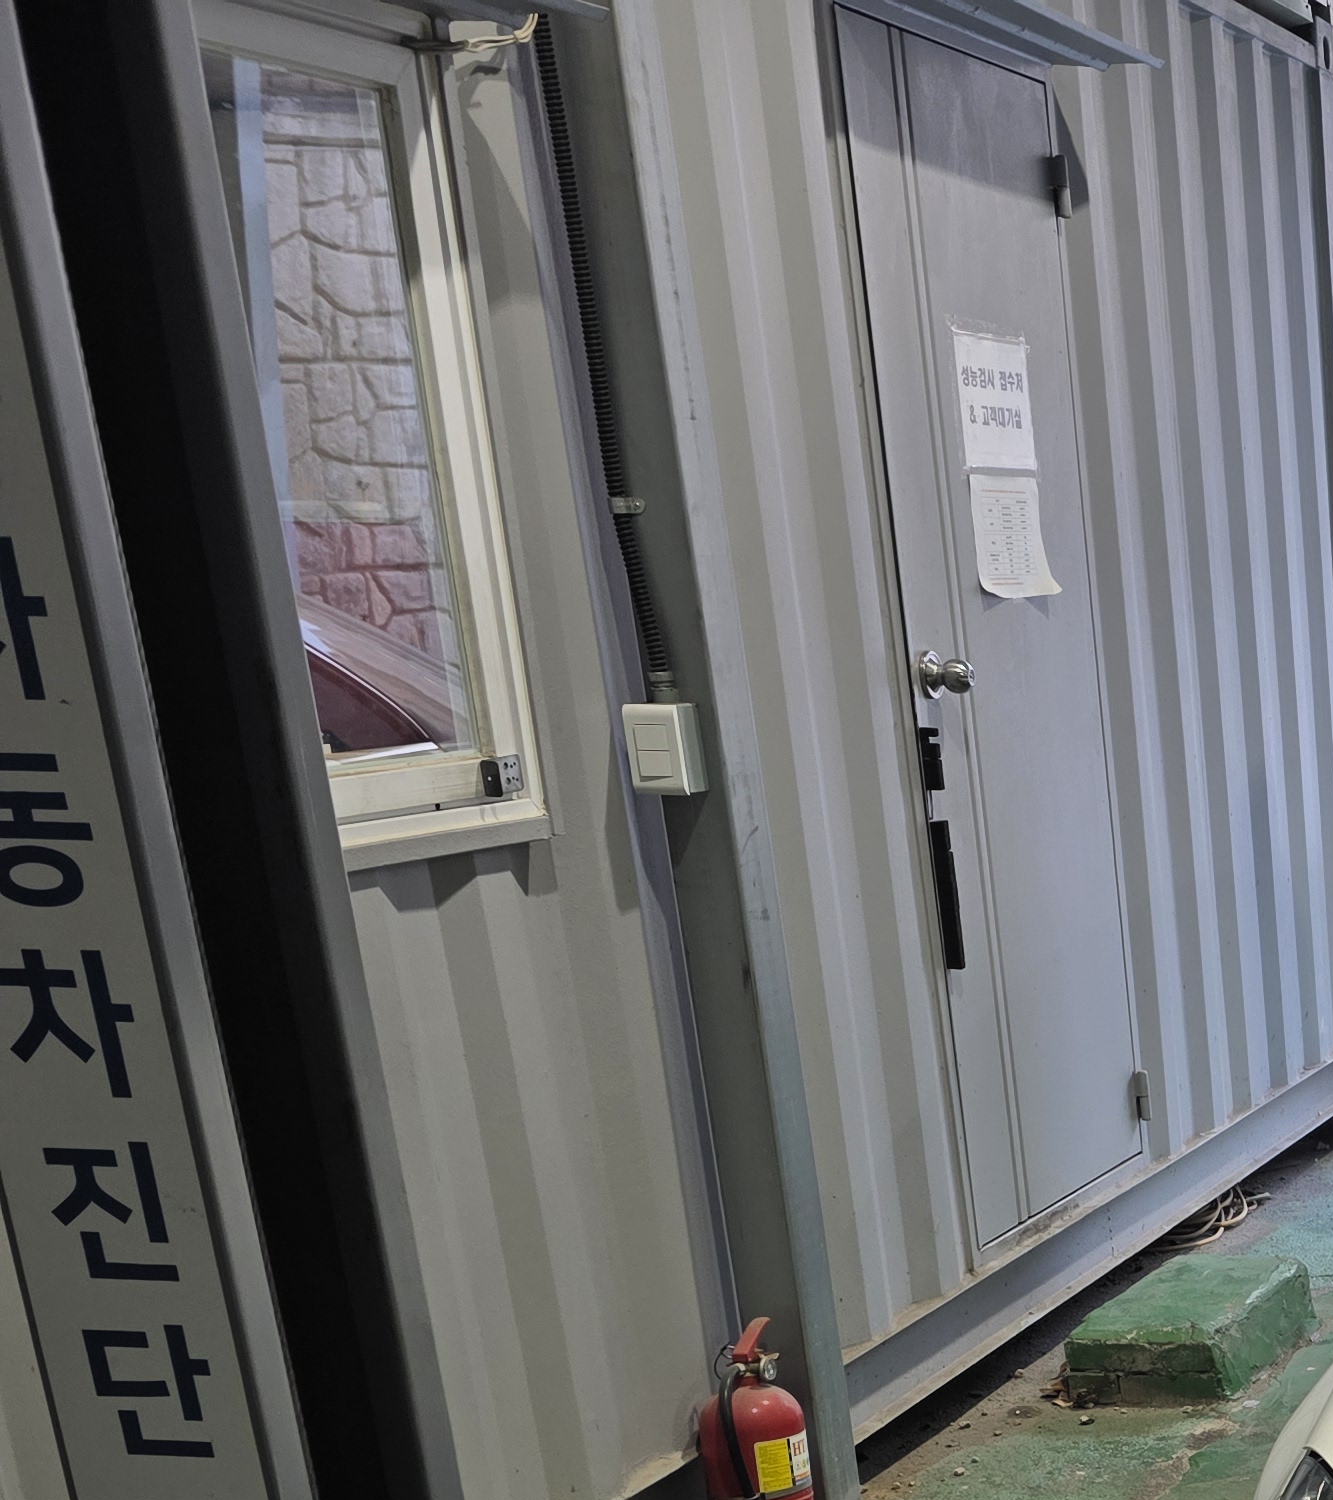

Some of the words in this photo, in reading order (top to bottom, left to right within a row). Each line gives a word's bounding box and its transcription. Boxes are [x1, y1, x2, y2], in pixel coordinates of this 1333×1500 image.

[961, 365, 995, 390] 성능검사
[999, 370, 1024, 393] 접수처
[969, 404, 978, 424] &
[981, 405, 1023, 430] 고객대기실
